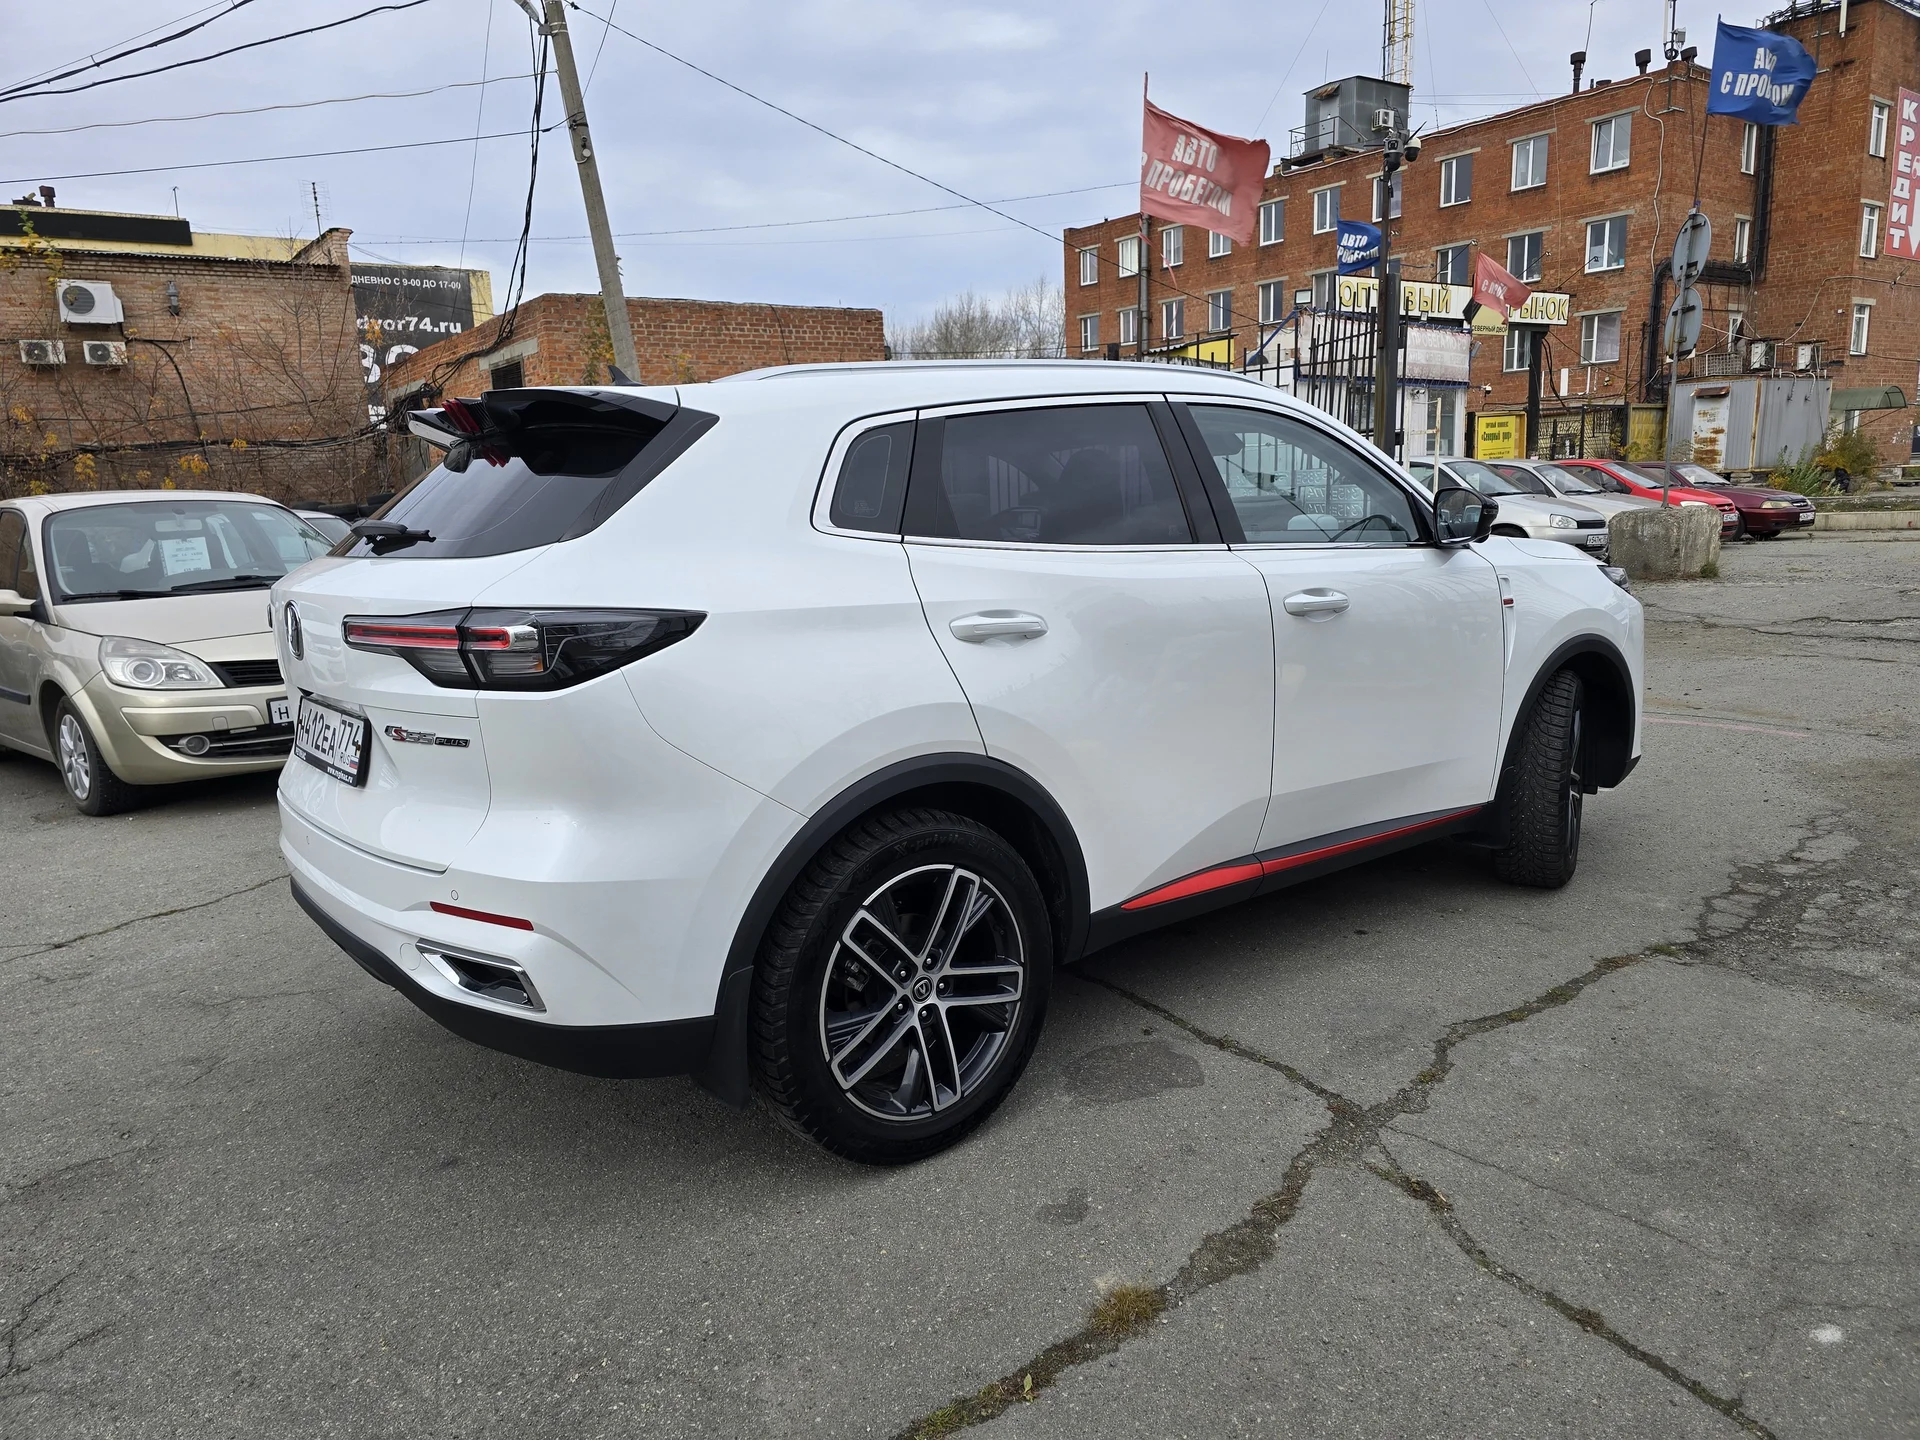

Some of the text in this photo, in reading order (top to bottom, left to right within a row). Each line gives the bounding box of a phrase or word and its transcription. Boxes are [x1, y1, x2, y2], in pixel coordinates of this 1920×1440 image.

[1720, 71, 1733, 94] С
[1171, 134, 1218, 173] АВТО
[1144, 159, 1233, 217] ПРОБЕГОМ
[1889, 98, 1919, 250] КРЕДИТ
[1340, 232, 1368, 248] АВТО
[393, 277, 400, 286] С
[402, 278, 421, 287] 9-00
[422, 279, 437, 289] ДО
[438, 280, 461, 290] 17-00
[1340, 280, 1451, 315] ОПВЫЙ
[298, 708, 361, 758] Н412ЕА 774
[434, 737, 470, 748] PLUS
[340, 751, 350, 766] RUS
